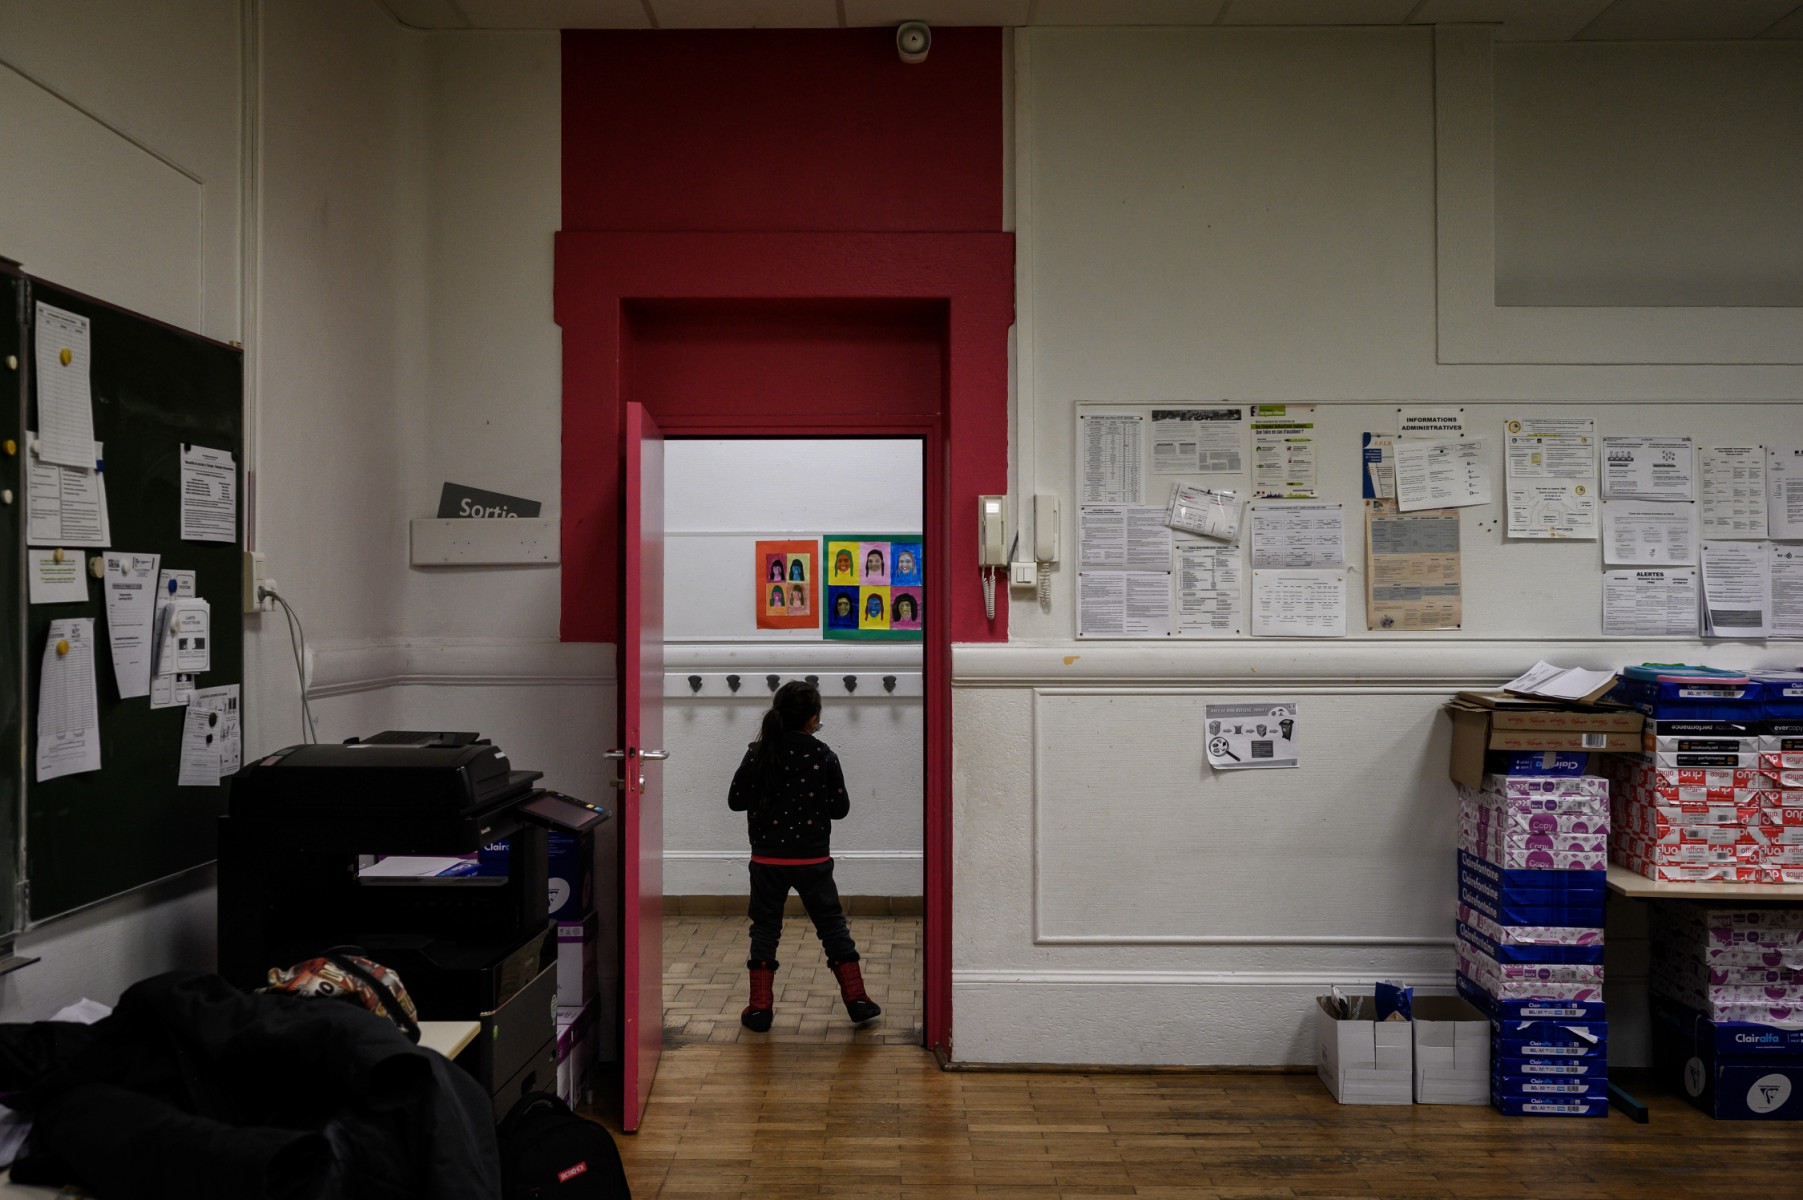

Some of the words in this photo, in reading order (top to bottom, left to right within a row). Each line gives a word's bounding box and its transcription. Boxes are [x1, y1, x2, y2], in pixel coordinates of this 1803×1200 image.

[1535, 761, 1578, 770] Claira
[1710, 770, 1729, 779] office
[1532, 821, 1554, 831] Copy
[1528, 842, 1549, 850] Copy
[1461, 852, 1499, 882] Clairefontaine
[1528, 860, 1550, 868] Copy
[1461, 870, 1498, 901] Clairefontaine
[1462, 888, 1498, 918] Clairefontaine
[1459, 924, 1495, 956] Clairefontaine
[1735, 1032, 1780, 1043] Clairalfa
